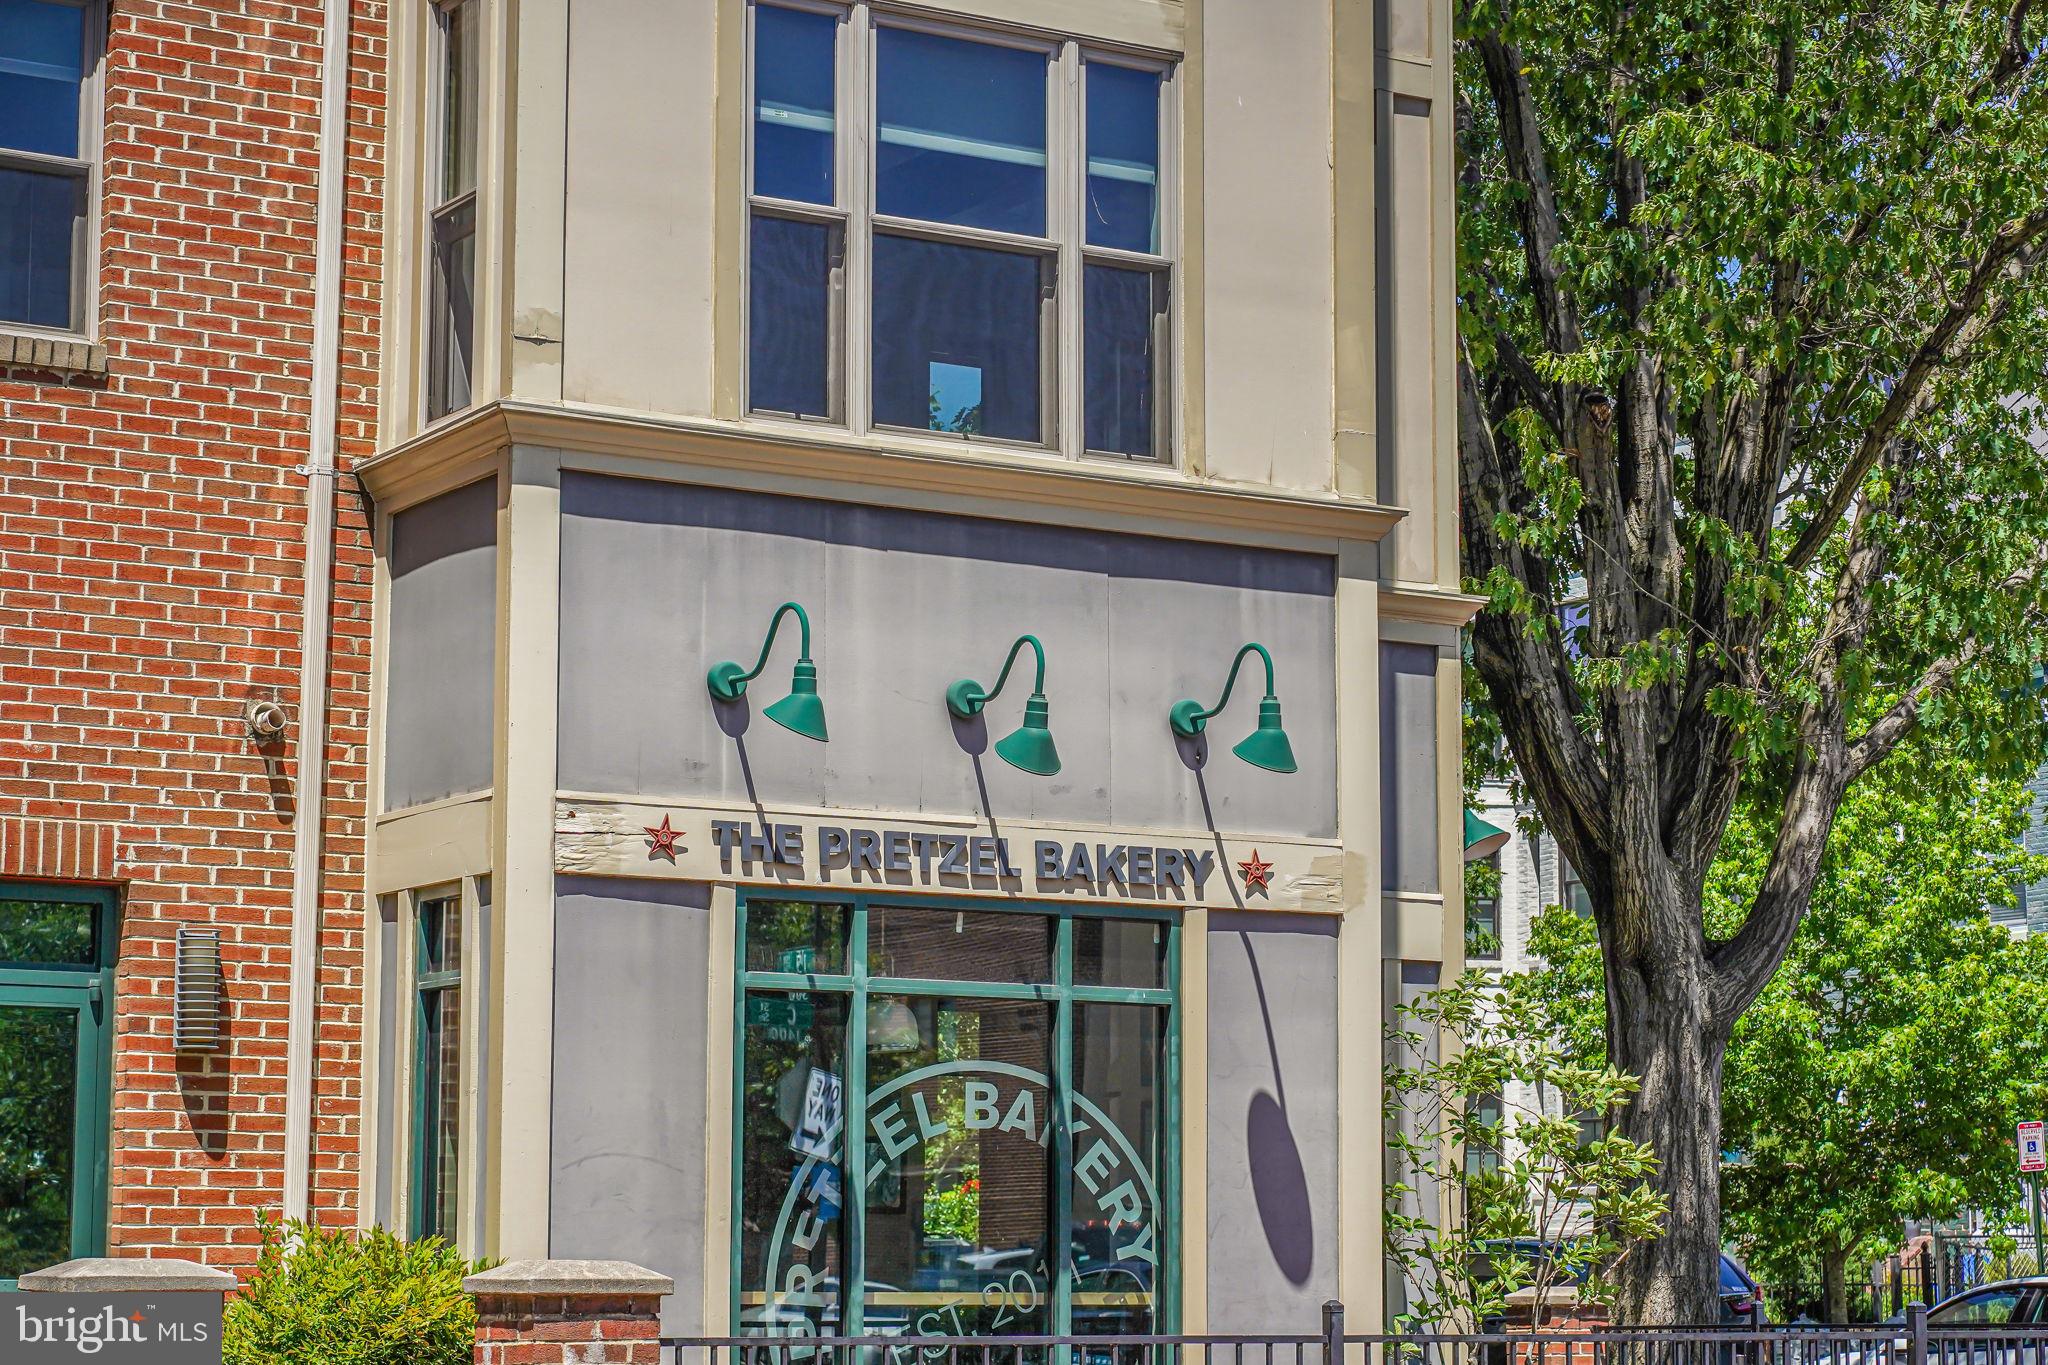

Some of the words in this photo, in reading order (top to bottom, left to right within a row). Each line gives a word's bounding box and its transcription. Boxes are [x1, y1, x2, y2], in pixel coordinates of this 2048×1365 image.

[711, 820, 803, 864] THE
[818, 826, 1022, 878] PRETZEL
[1034, 840, 1214, 887] BAKERY
